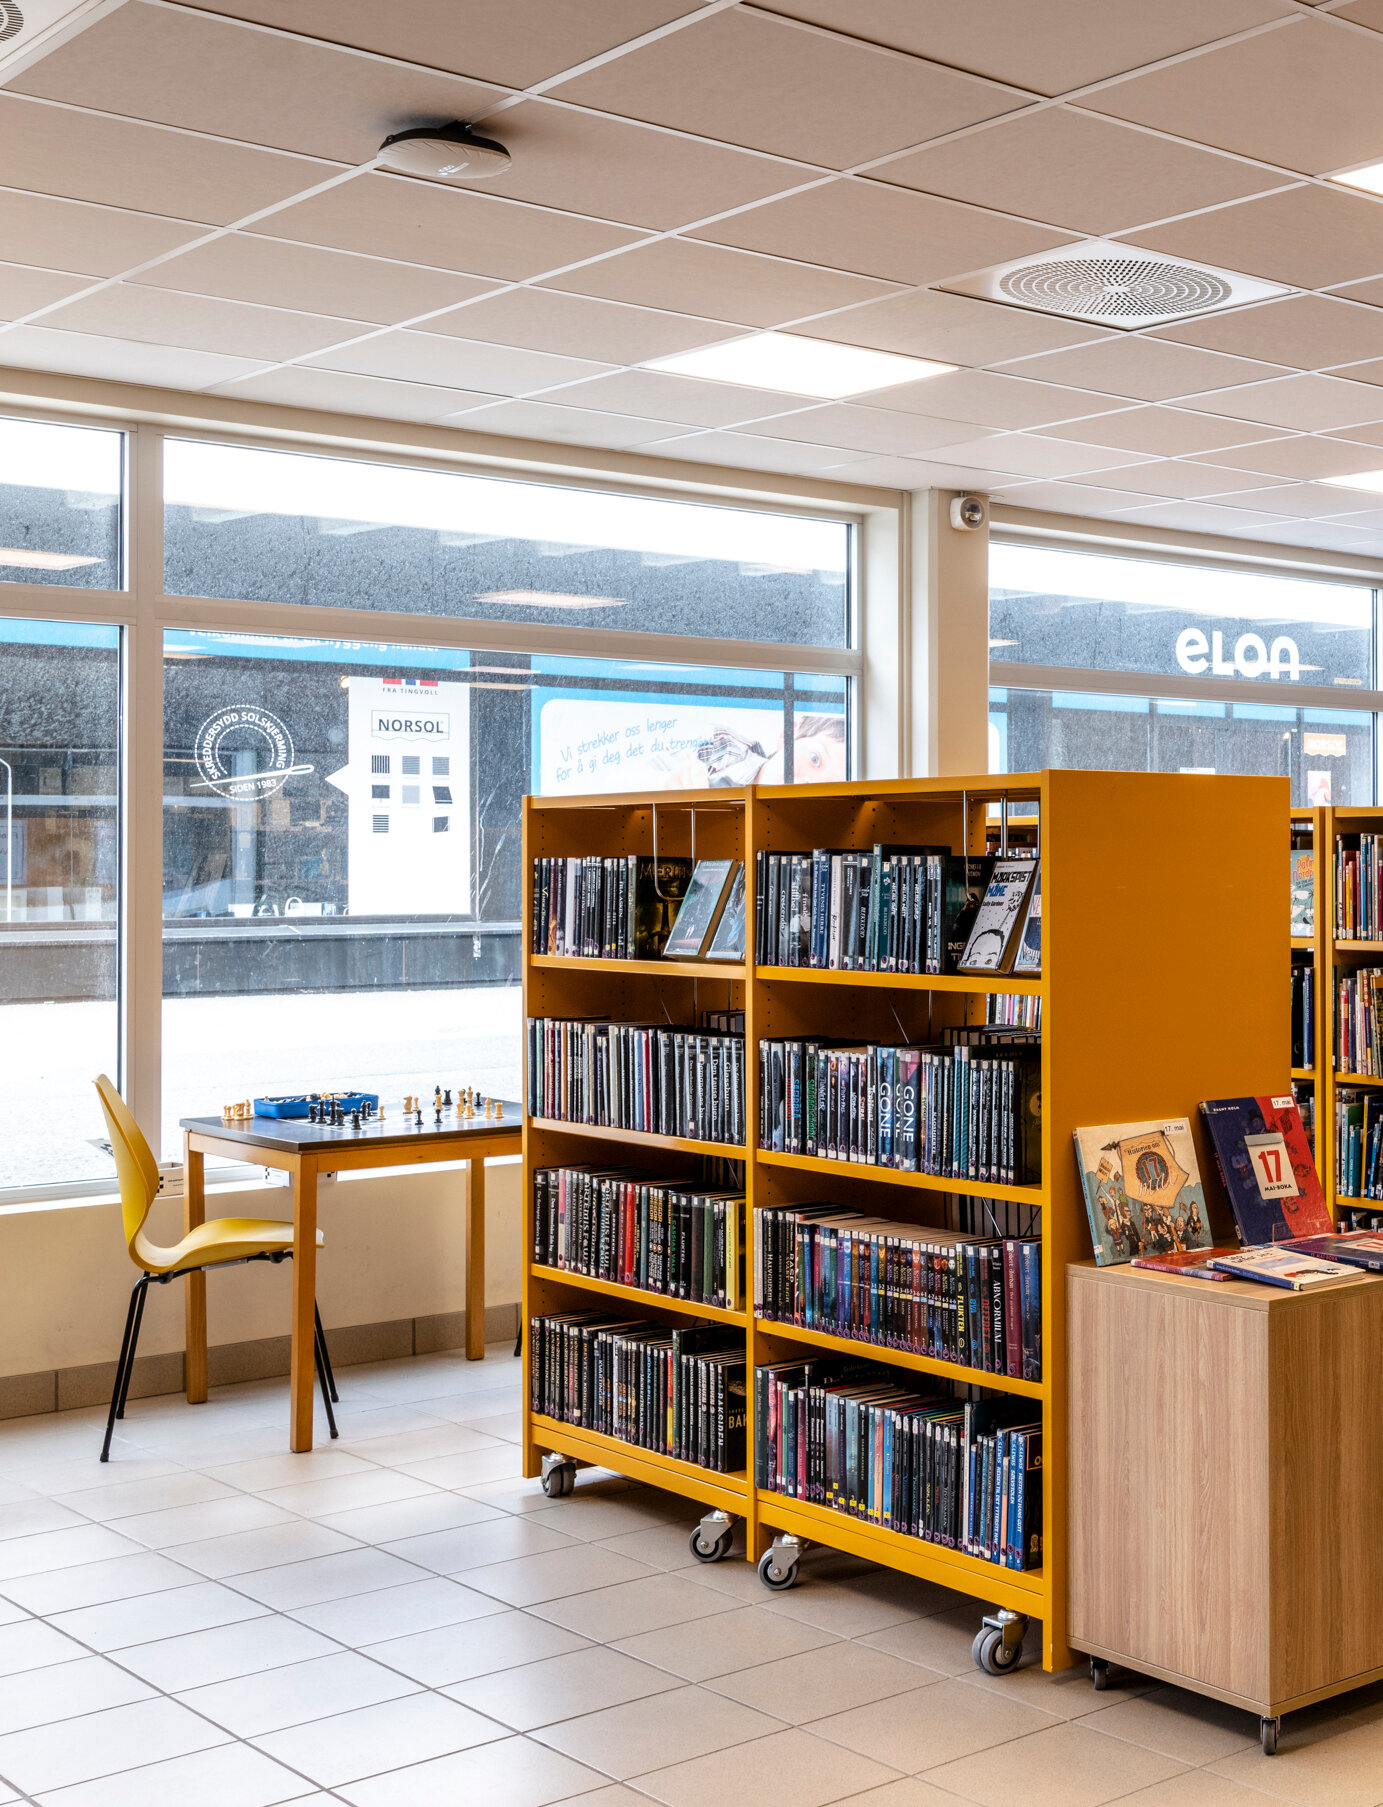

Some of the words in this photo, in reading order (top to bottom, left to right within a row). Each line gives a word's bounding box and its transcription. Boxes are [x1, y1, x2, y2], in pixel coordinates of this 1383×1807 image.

[378, 718, 444, 733] NORSOL
[560, 745, 573, 763] Vi
[577, 731, 620, 755] strekker
[625, 724, 640, 739] oss
[646, 717, 678, 733] lenger
[202, 712, 239, 780] SKREDDERSYDD
[241, 711, 287, 769] SOLSKJERMING
[556, 767, 572, 783] for
[577, 758, 583, 773] å
[588, 758, 597, 773] gi
[602, 749, 621, 765] deg
[625, 744, 644, 758] det
[651, 737, 664, 752] du
[229, 782, 255, 794] SIDEN
[256, 778, 277, 789] 1983
[986, 883, 1008, 897] MÅNE
[880, 1082, 891, 1138] GONE
[902, 1085, 914, 1143] GONE
[1141, 1157, 1160, 1181] 17
[1258, 1150, 1282, 1183] 17
[1264, 1183, 1293, 1192] MAI-BOKA
[957, 1295, 965, 1332] FLUKTEN
[993, 1280, 1002, 1342] ABNORMIUM
